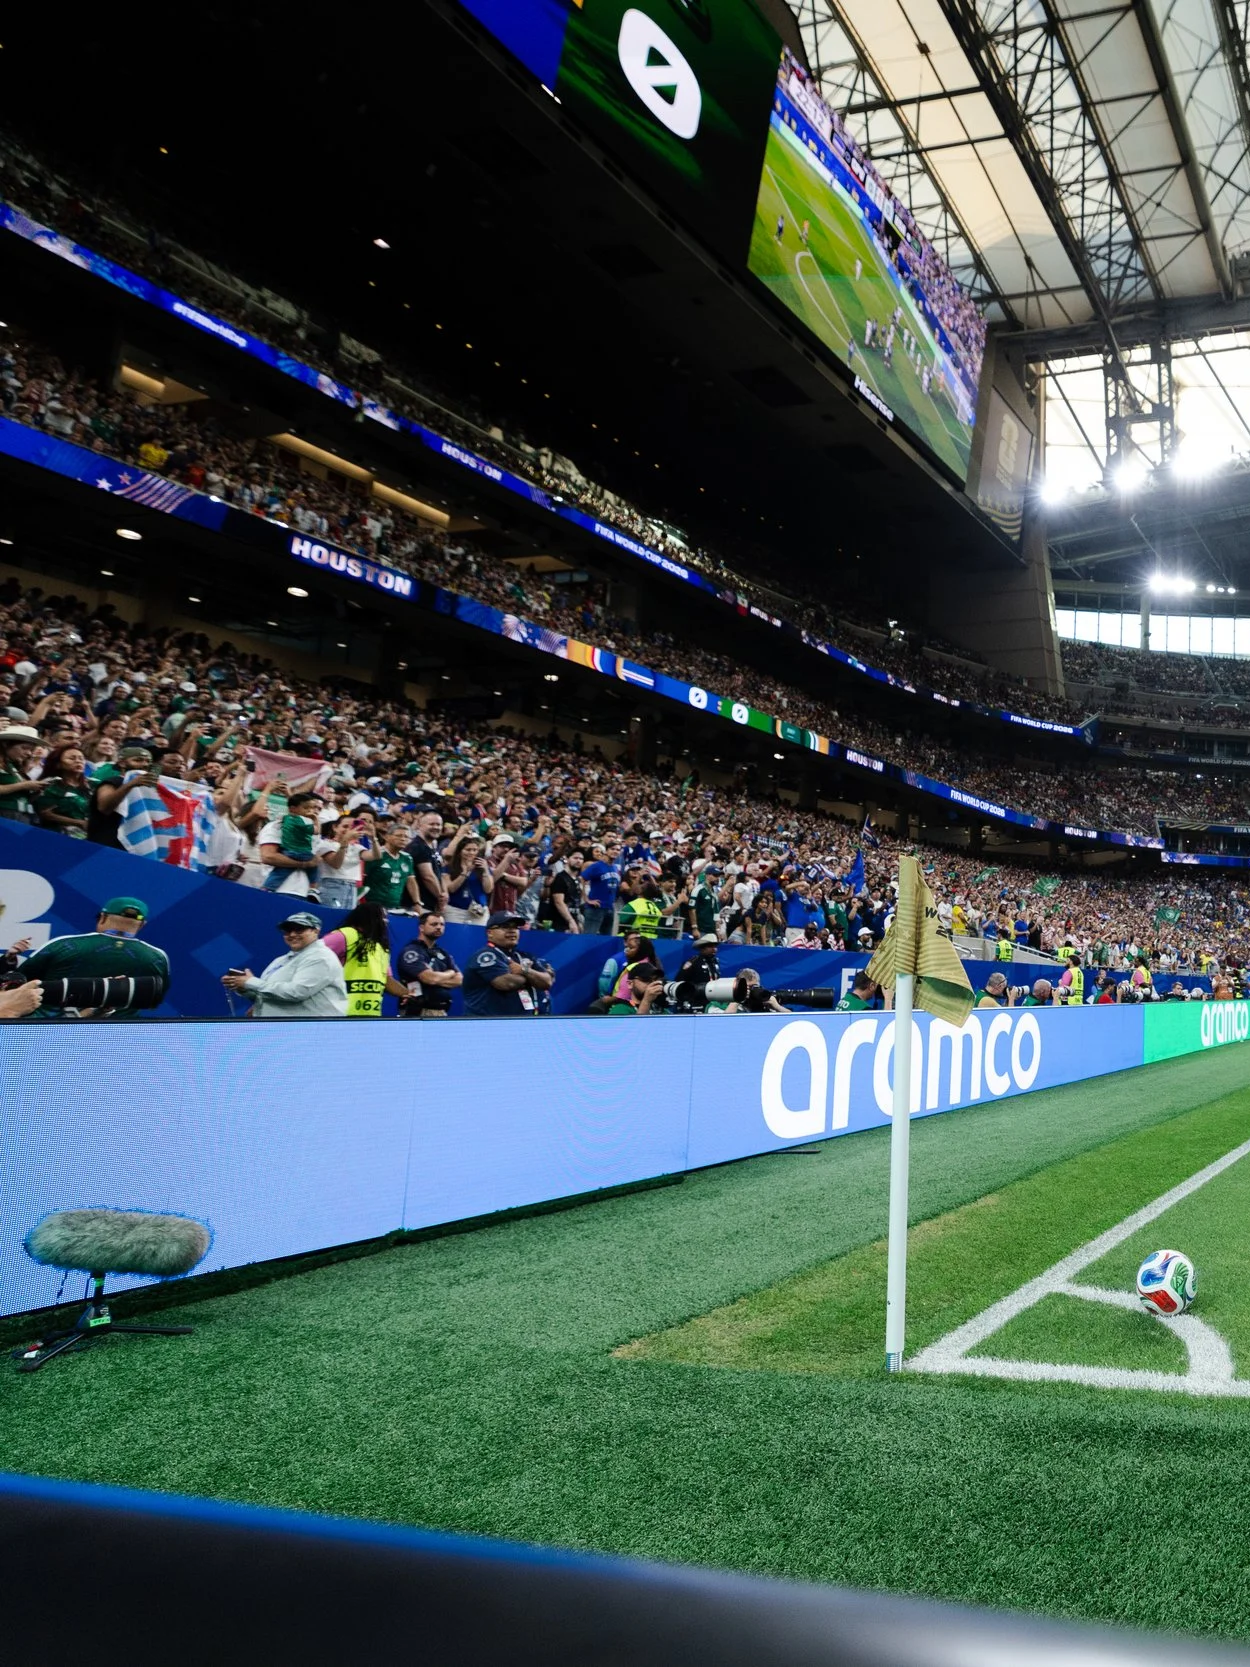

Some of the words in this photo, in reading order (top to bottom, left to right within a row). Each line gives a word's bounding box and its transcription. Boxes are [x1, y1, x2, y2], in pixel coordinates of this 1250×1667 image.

[854, 374, 894, 422] Hisense
[442, 443, 502, 480] HOUSTON
[291, 536, 411, 596] HOUSTON
[1010, 715, 1022, 723] FIFA
[1022, 718, 1041, 728] WORLD
[846, 750, 883, 772] HOUSTON
[951, 789, 962, 801] FIFA
[962, 794, 980, 807] WORLD
[980, 801, 990, 811] CUP
[1064, 826, 1098, 839] HOUSTON
[1201, 1001, 1250, 1048] aramco
[761, 1012, 1042, 1139] aramco
